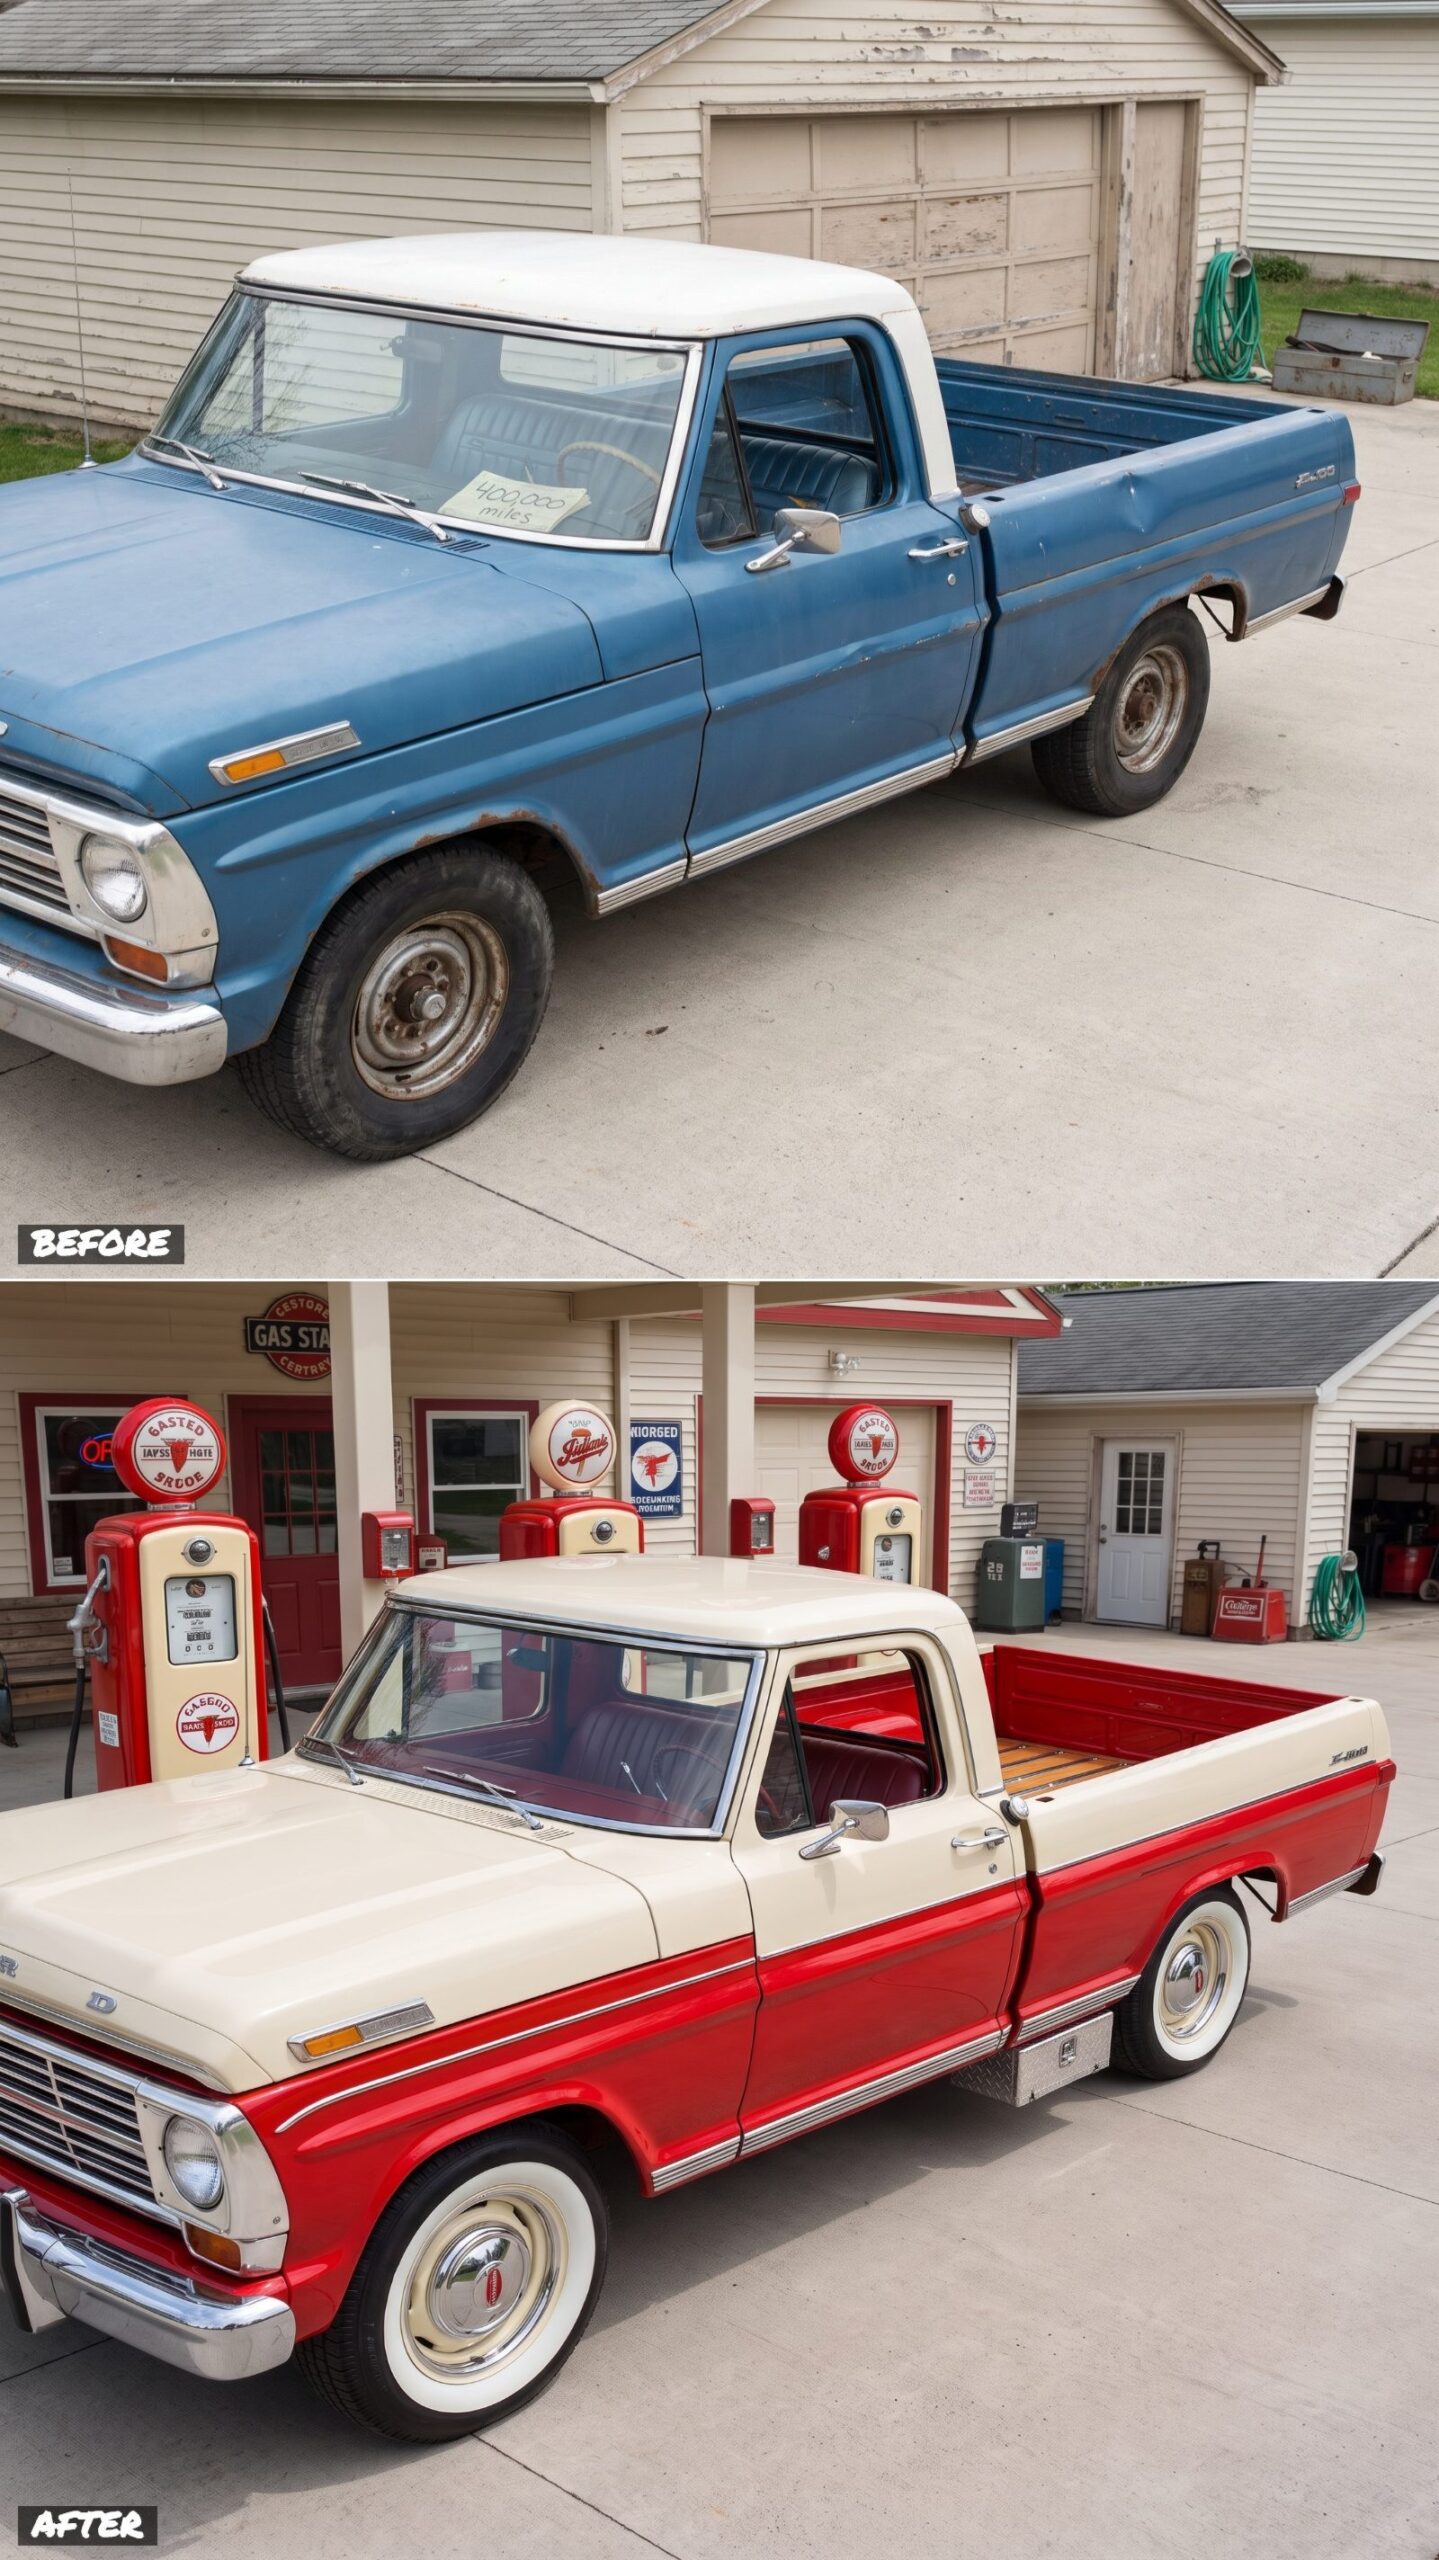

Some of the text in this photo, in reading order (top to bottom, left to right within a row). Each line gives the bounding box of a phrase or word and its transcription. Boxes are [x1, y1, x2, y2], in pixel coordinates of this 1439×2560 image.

[476, 481, 566, 510] 400,000
[479, 506, 533, 524] miles
[254, 1324, 292, 1348] GAS
[86, 1991, 118, 2015] D
